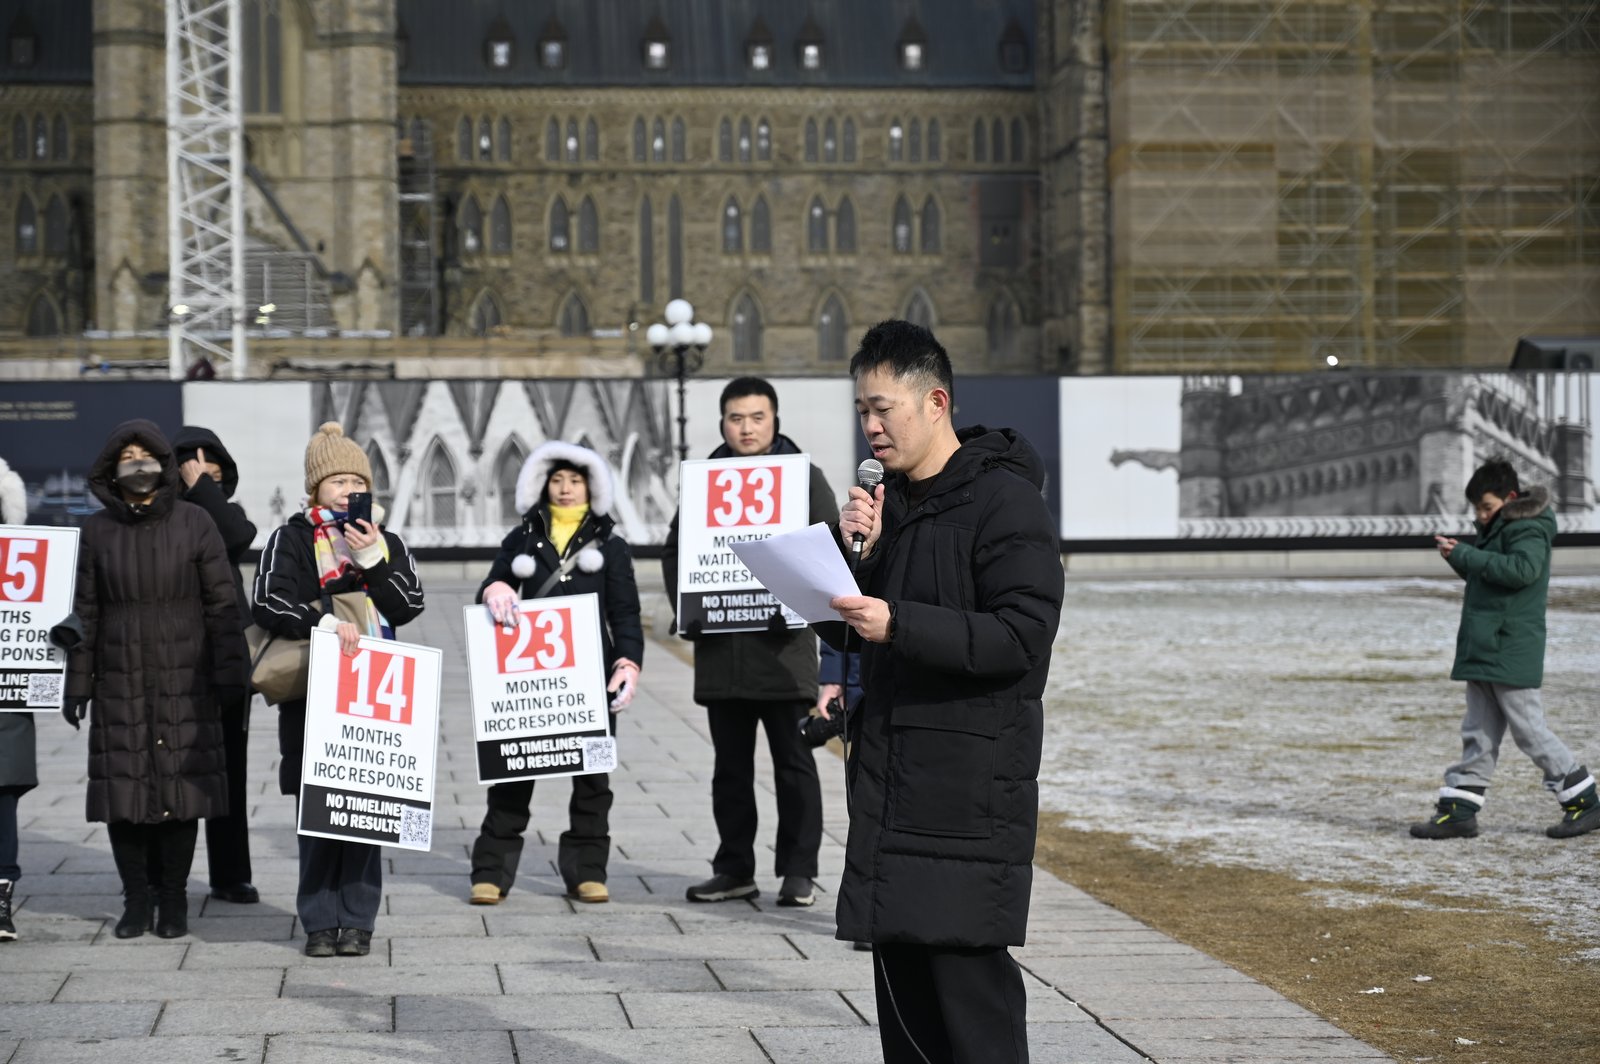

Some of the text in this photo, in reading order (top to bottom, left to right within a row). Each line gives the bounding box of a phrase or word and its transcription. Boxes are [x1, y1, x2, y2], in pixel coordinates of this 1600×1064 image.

[713, 467, 775, 526] 33
[698, 553, 740, 566] WAITI
[0, 539, 38, 602] 5
[689, 571, 719, 584] IRCC
[702, 595, 720, 609] NO
[707, 609, 725, 623] NO
[16, 629, 48, 643] FOR
[502, 609, 567, 673] 23
[0, 673, 29, 686] LINE
[348, 649, 407, 722] 14
[506, 676, 568, 694] MONTHS
[491, 693, 586, 714] WAITING FOR
[484, 709, 597, 733] IRCC RESPONSE
[341, 724, 402, 748] MONTHS
[500, 736, 583, 757] NO TIMELINES
[325, 742, 417, 770] WAITING FOR
[507, 752, 581, 771] NO RESULTS
[313, 762, 424, 792] IRCC RESPONSE
[326, 793, 344, 808] NO
[330, 811, 402, 834] NO RESULTS
